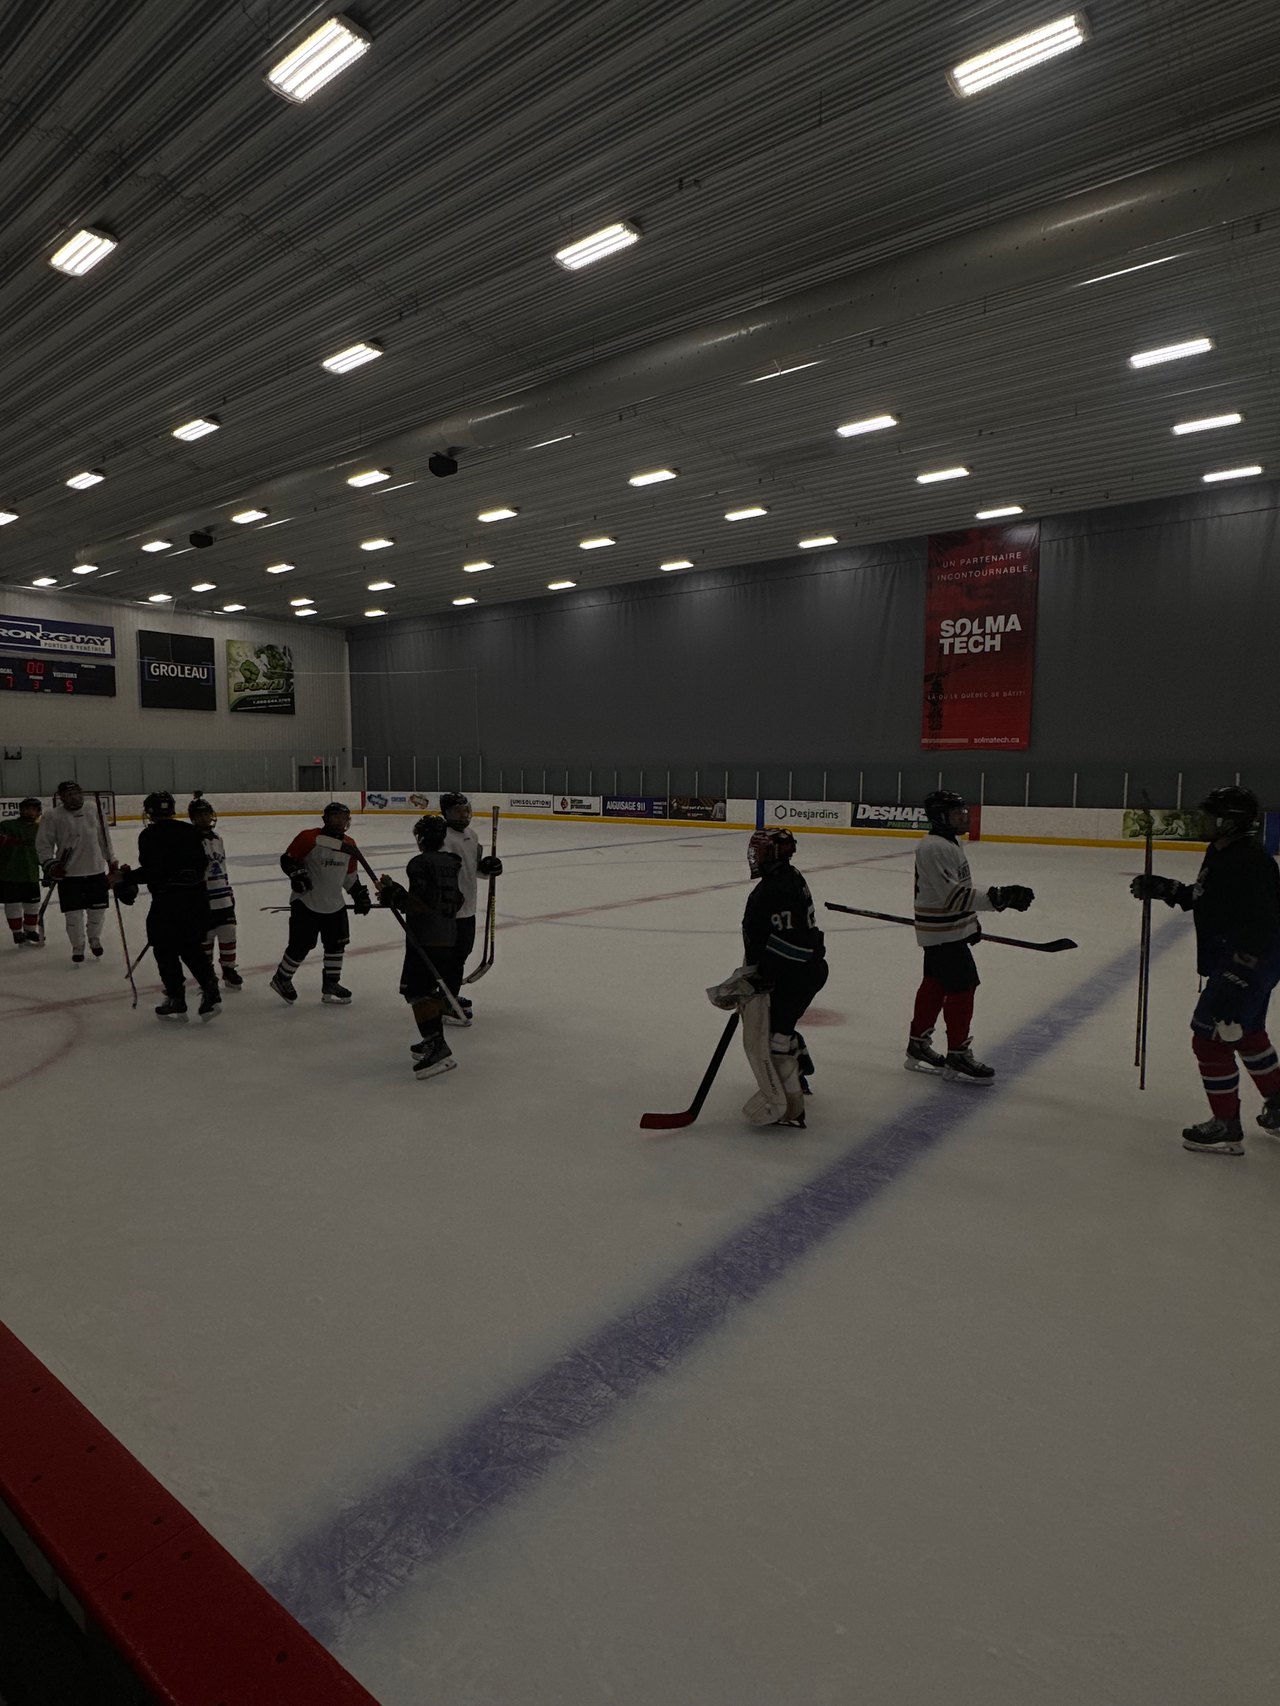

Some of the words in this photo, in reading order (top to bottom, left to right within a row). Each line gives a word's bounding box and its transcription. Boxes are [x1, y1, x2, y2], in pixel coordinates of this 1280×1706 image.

[943, 560, 956, 569] UN
[960, 551, 1022, 566] PARTENAIRE
[940, 613, 1022, 638] SOLMA
[939, 633, 1002, 655] TECH
[150, 663, 208, 680] GROLEAU
[789, 807, 839, 820] Desjardins
[856, 803, 929, 822] DESHAR
[770, 910, 793, 931] 97
